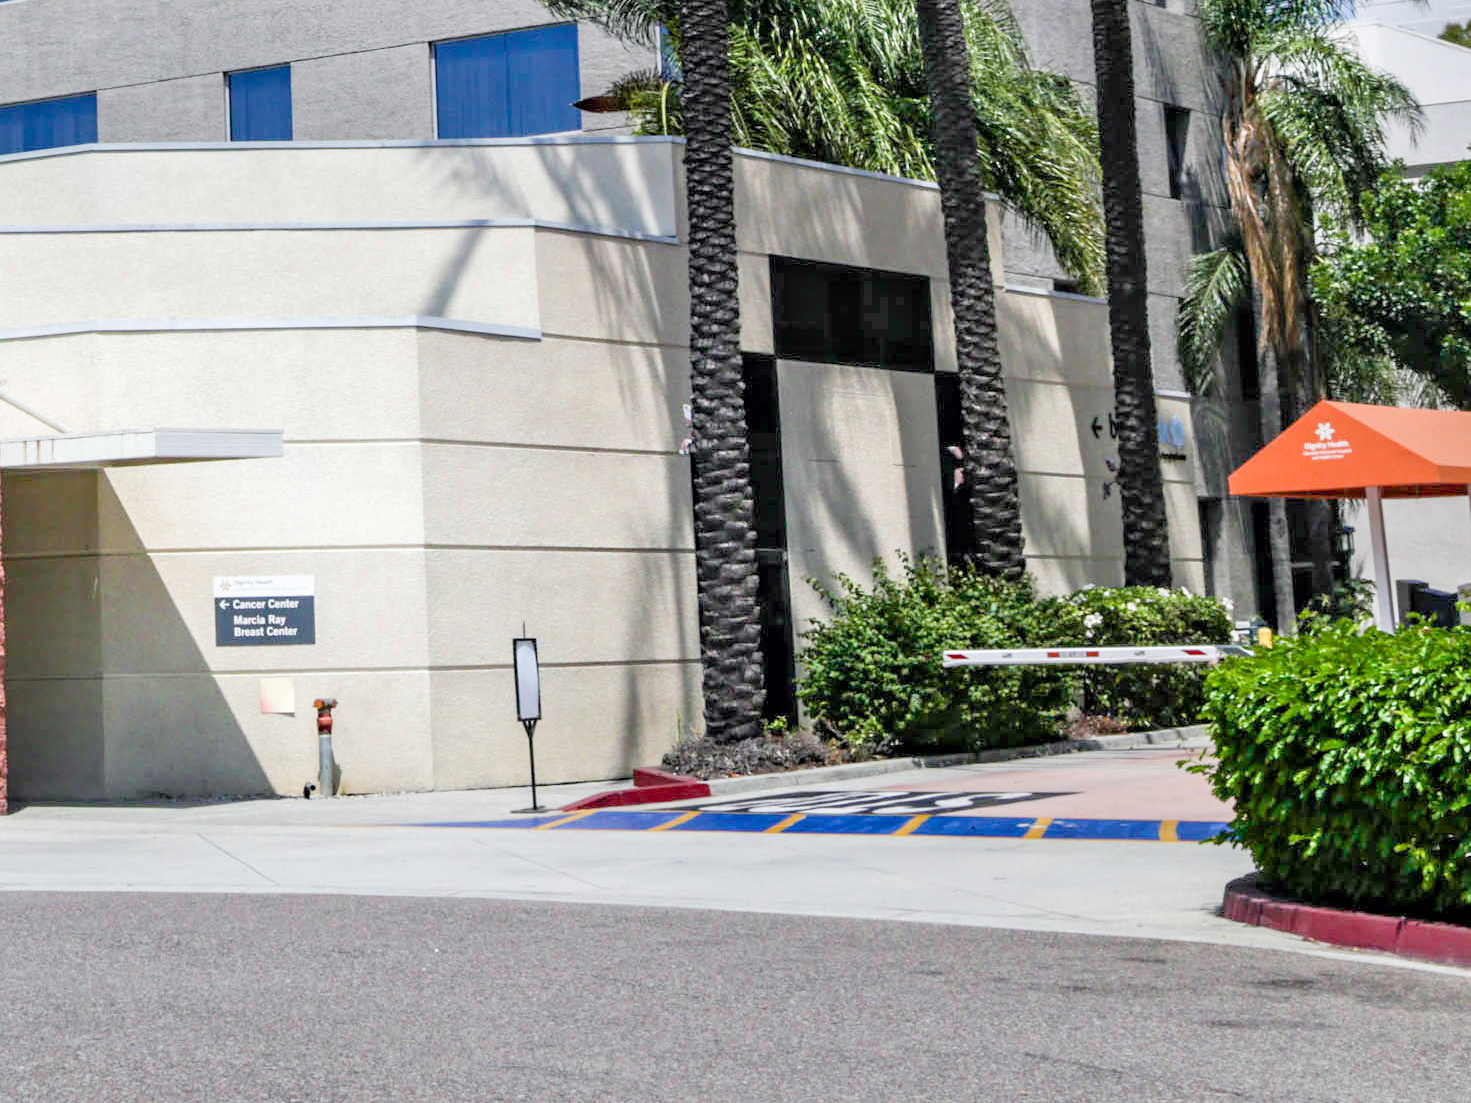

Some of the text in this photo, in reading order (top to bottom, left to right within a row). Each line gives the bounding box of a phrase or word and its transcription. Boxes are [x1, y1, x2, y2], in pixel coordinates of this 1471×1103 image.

[232, 599, 299, 610] Cancer Center
[233, 614, 286, 627] Marcia Ray
[233, 626, 298, 637] Breast Center
